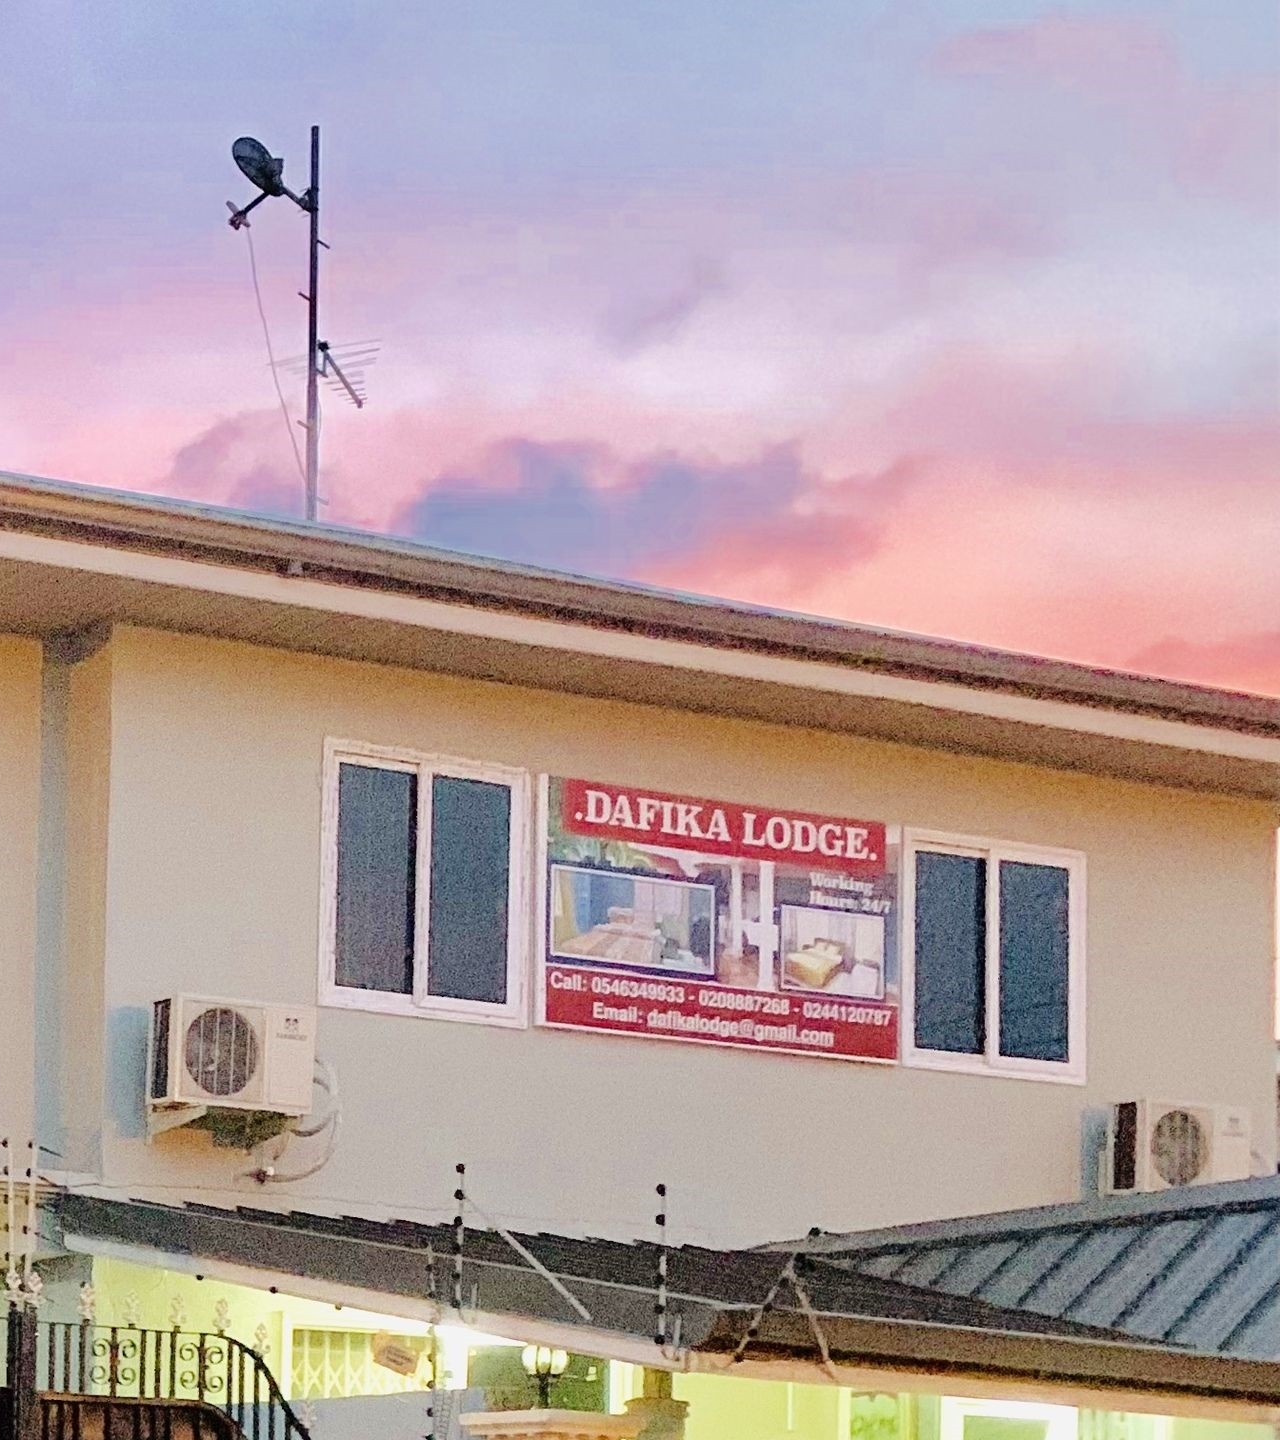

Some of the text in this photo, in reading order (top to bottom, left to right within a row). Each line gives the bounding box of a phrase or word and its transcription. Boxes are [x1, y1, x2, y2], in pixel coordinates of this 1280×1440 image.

[742, 812, 878, 861] LODGE.
[809, 872, 875, 896] Working
[861, 898, 891, 914] 24/7
[550, 971, 588, 992] Call:
[591, 977, 685, 1003] 0546349933
[593, 1002, 835, 1047] Email: dafikalodge@gmail.com
